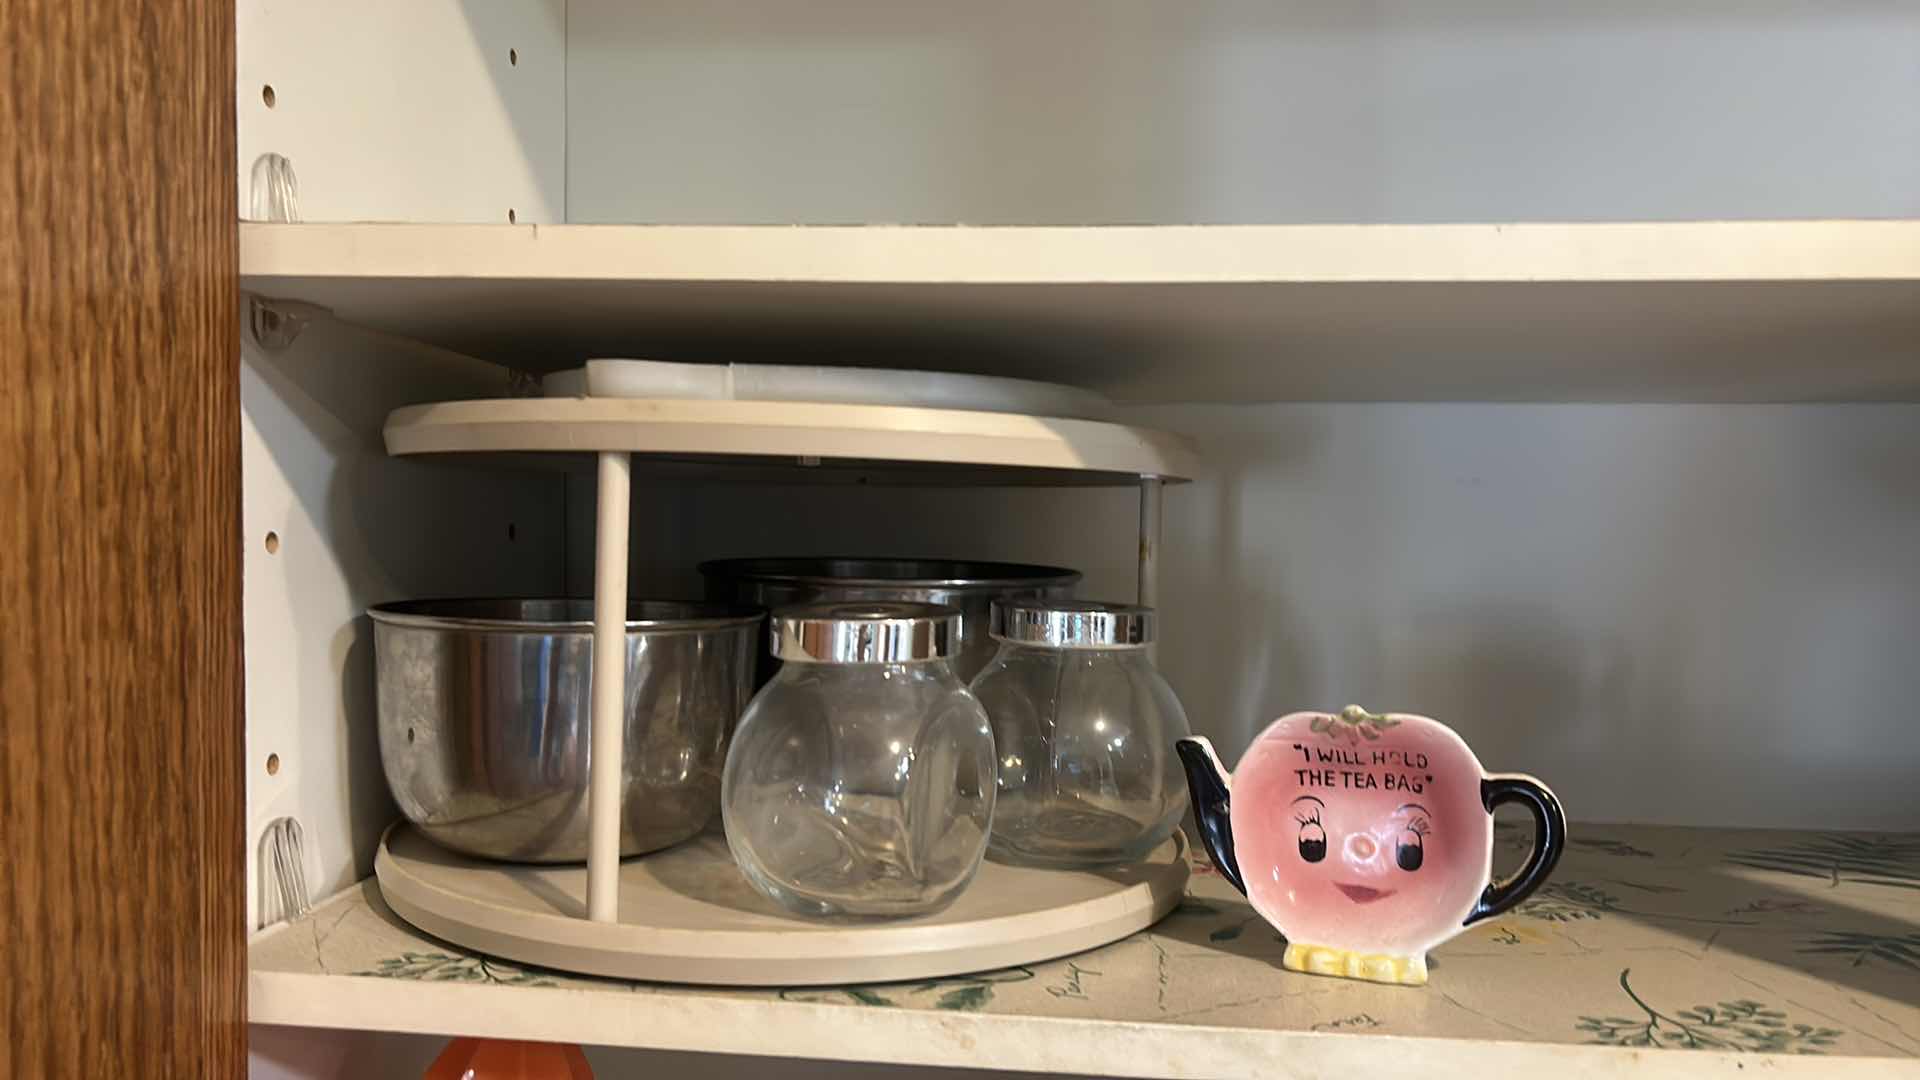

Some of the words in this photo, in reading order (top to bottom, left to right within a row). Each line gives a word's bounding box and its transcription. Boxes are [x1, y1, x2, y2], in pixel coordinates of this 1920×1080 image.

[1317, 748, 1365, 765] WILL
[1294, 770, 1335, 787] THE
[1339, 772, 1377, 789] TEA
